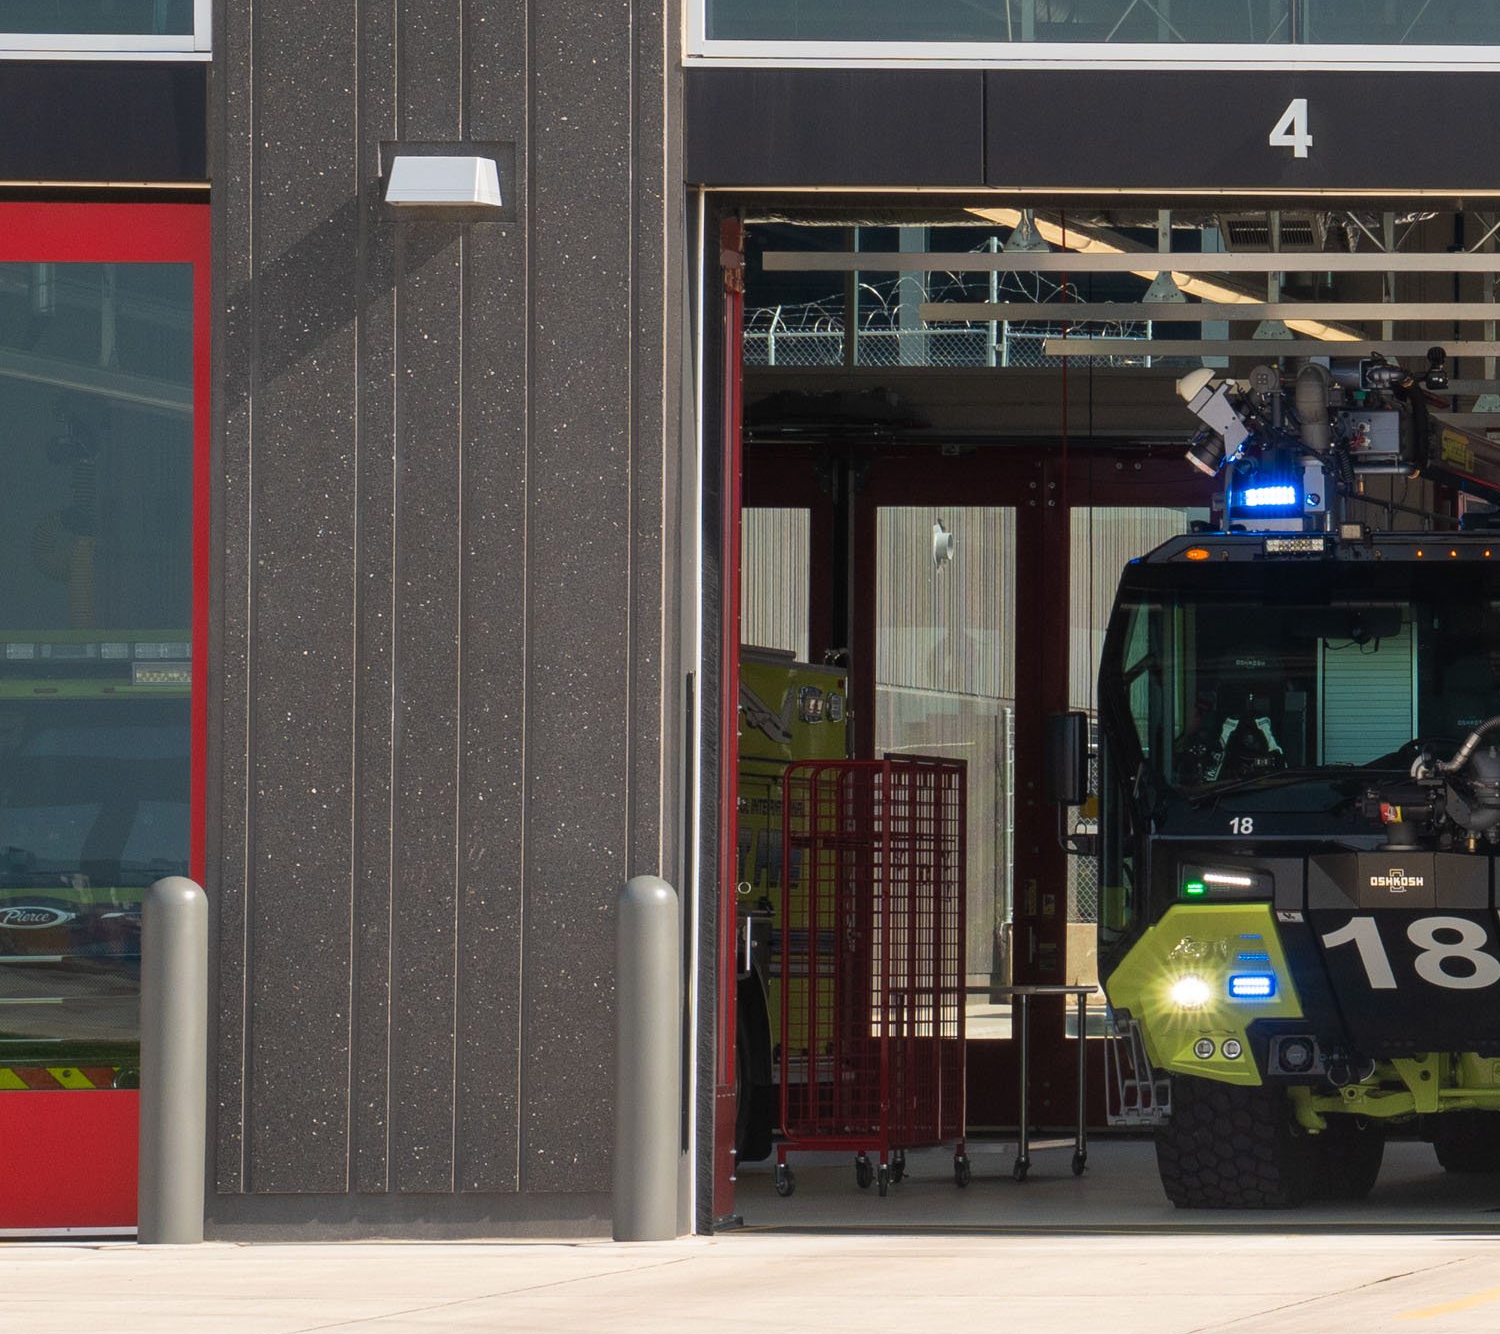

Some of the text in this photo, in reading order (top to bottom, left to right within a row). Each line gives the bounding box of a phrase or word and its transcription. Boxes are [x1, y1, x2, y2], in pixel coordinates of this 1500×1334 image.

[1269, 98, 1313, 158] 4
[1229, 817, 1254, 835] 18
[1370, 875, 1424, 887] OSHKOSH
[2, 909, 51, 925] Pierce
